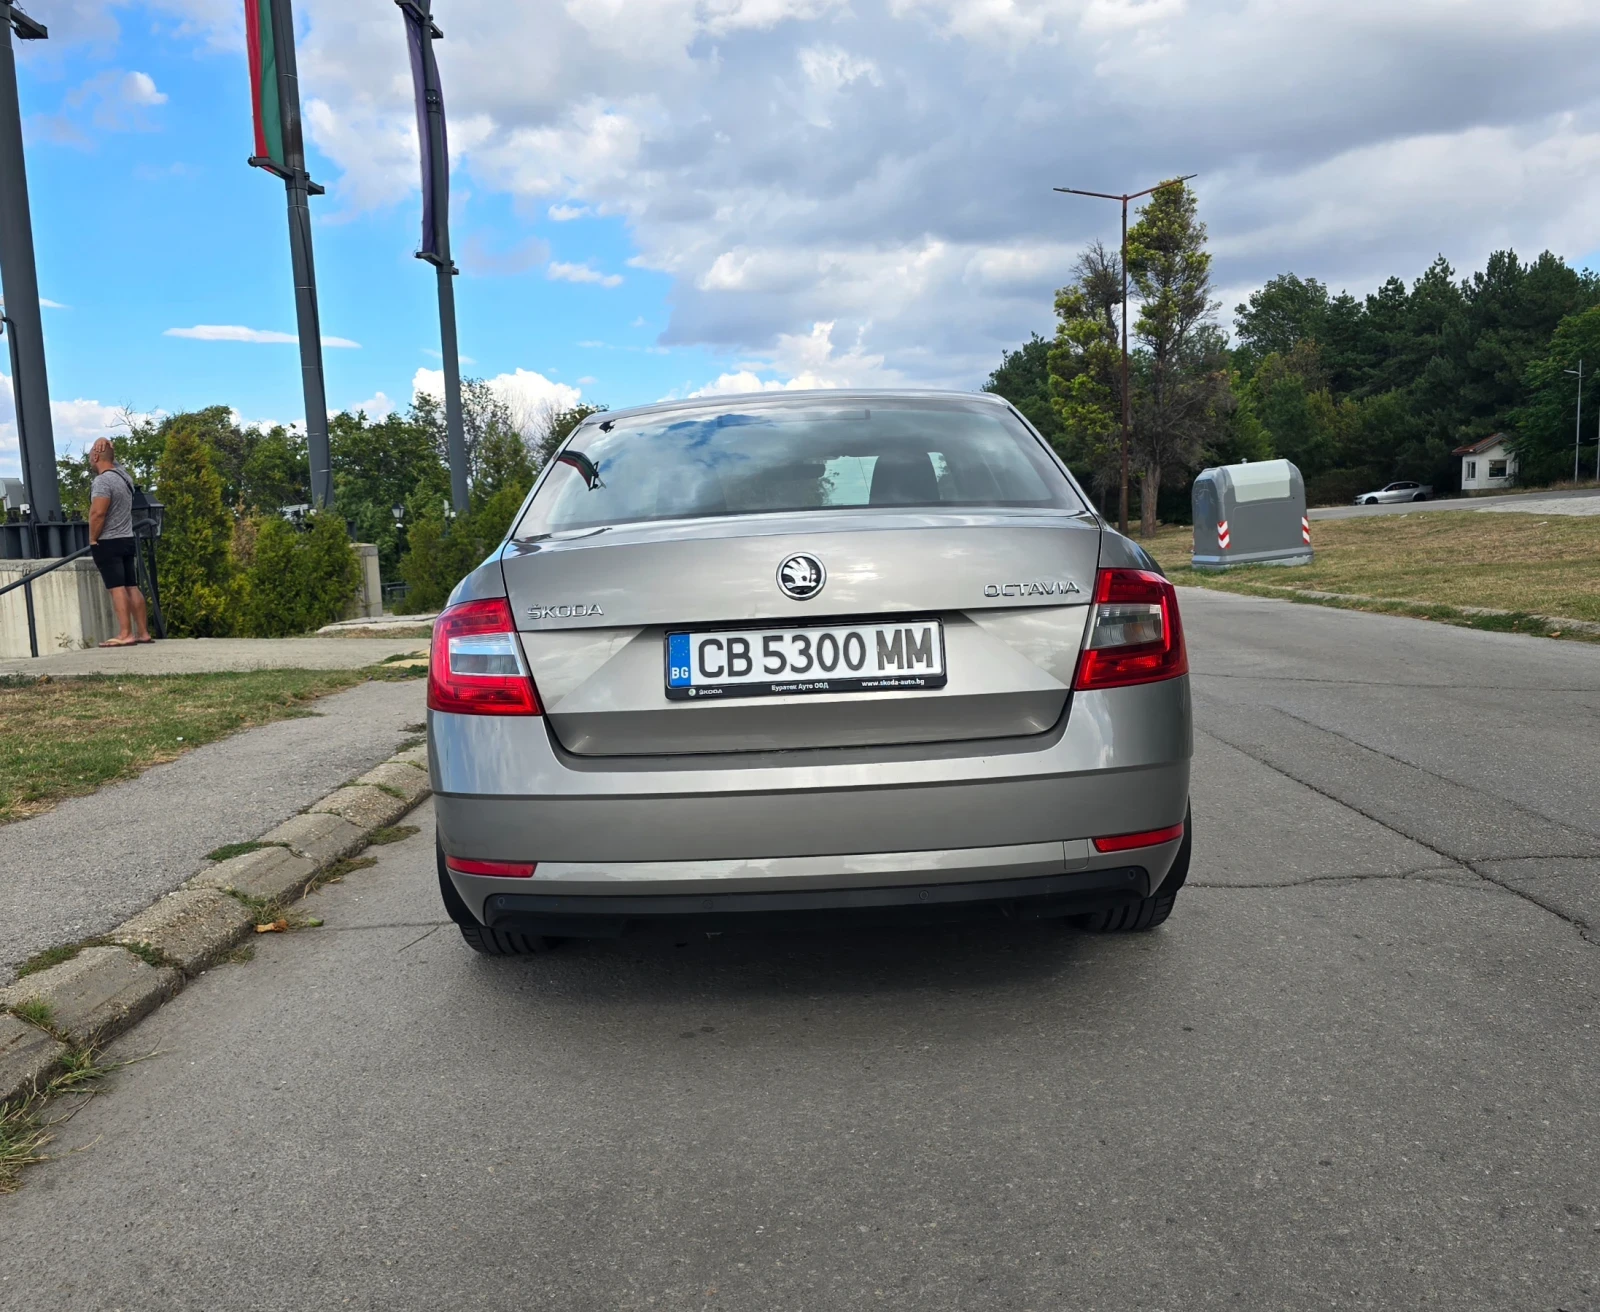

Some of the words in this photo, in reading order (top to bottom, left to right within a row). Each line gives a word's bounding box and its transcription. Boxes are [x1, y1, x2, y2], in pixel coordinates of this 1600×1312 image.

[984, 581, 1080, 597] OCTAVIA
[527, 603, 604, 620] ŠKODA
[698, 637, 753, 678] CB
[762, 631, 866, 675] 5300
[875, 627, 933, 671] MM
[671, 667, 689, 679] BG
[861, 678, 925, 686] www.skoda-auto.bg
